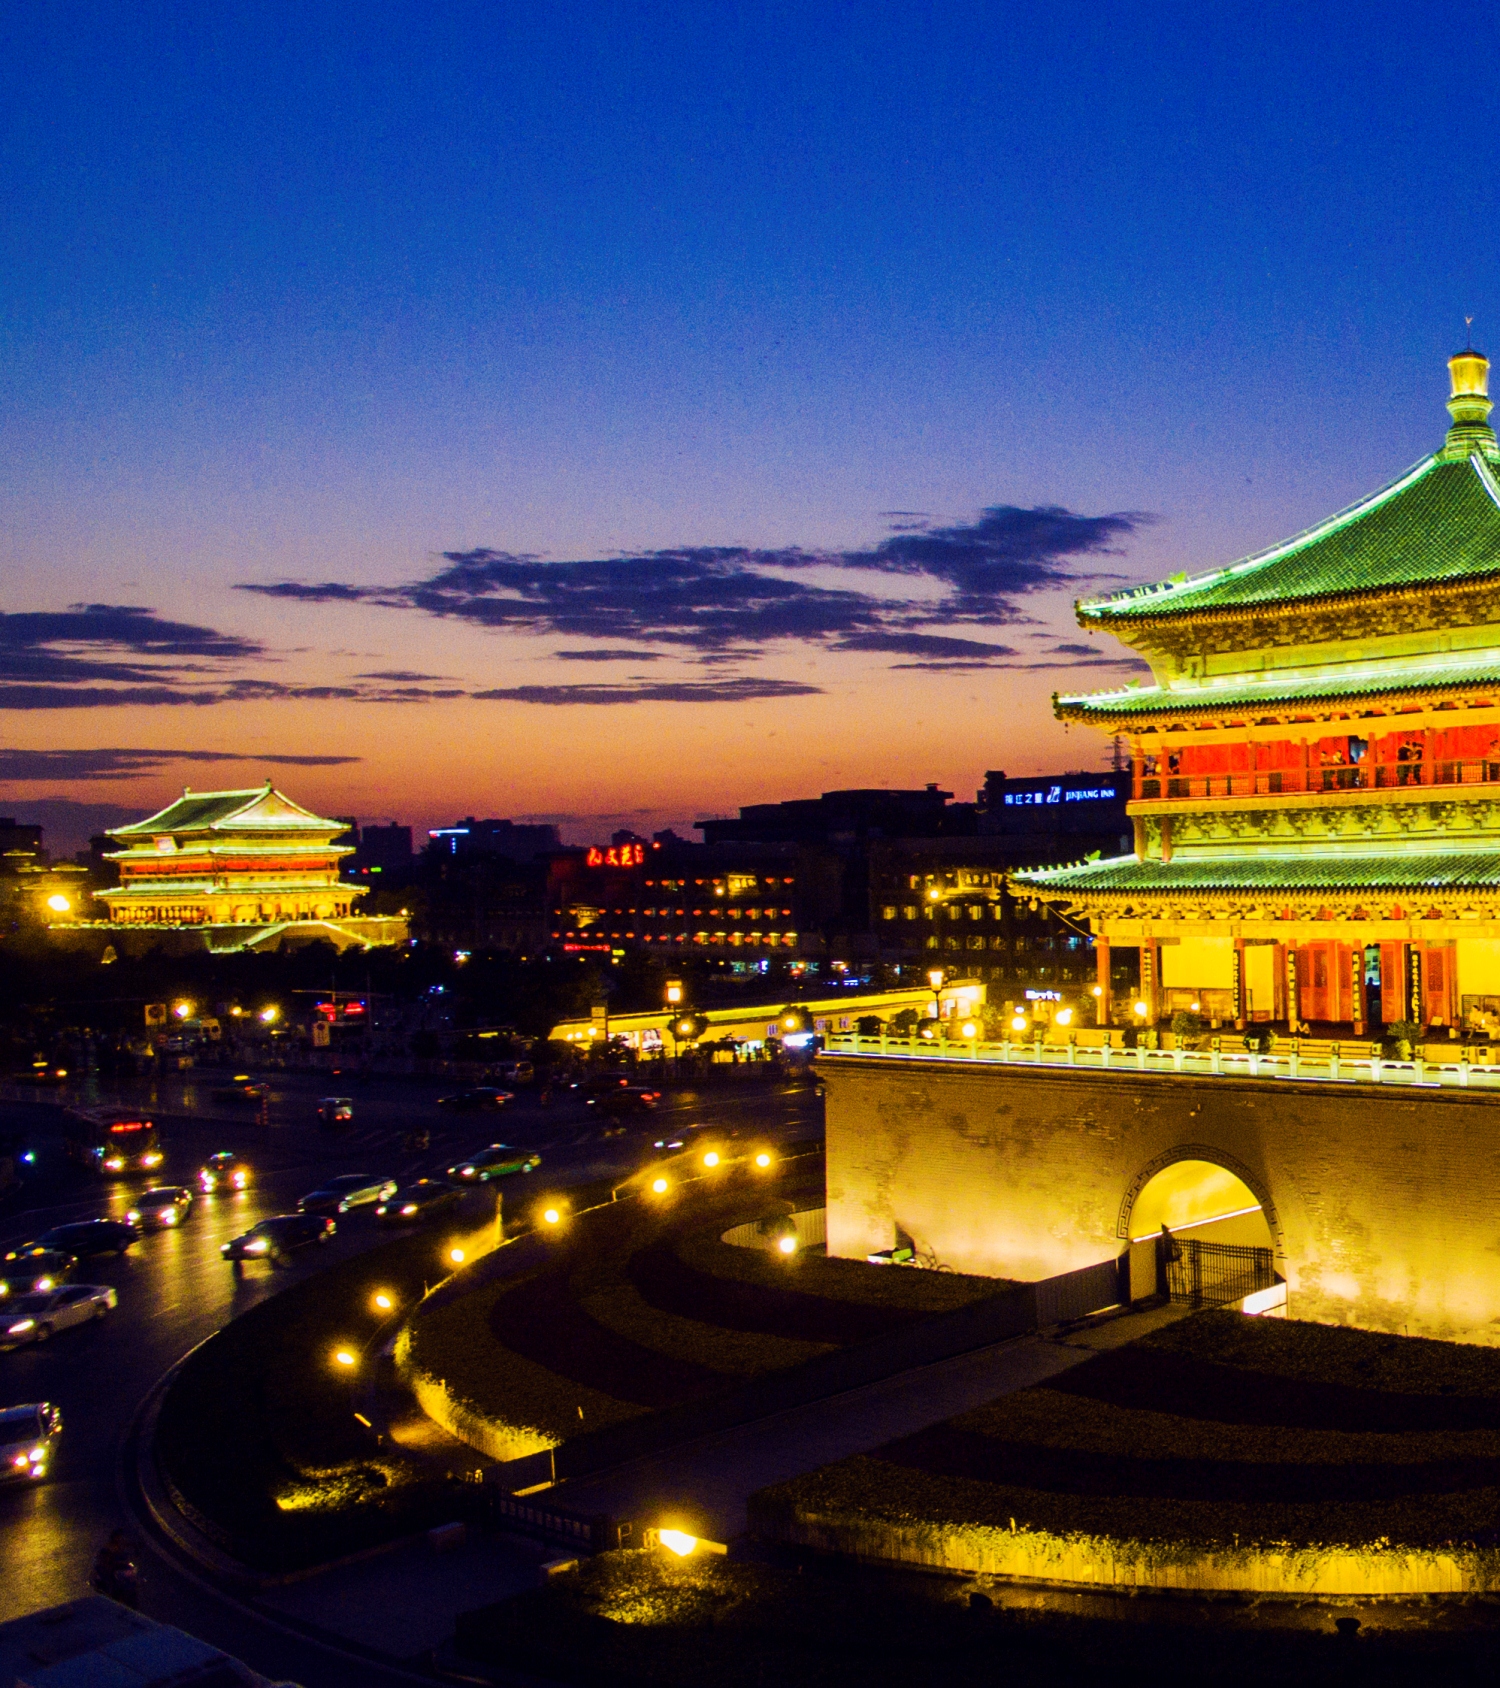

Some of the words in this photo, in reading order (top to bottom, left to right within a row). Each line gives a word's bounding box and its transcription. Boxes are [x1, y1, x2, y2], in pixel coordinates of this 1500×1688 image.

[1005, 793, 1043, 805] 锦江之星
[1065, 790, 1099, 801] JINJIANG
[1100, 789, 1115, 798] INN
